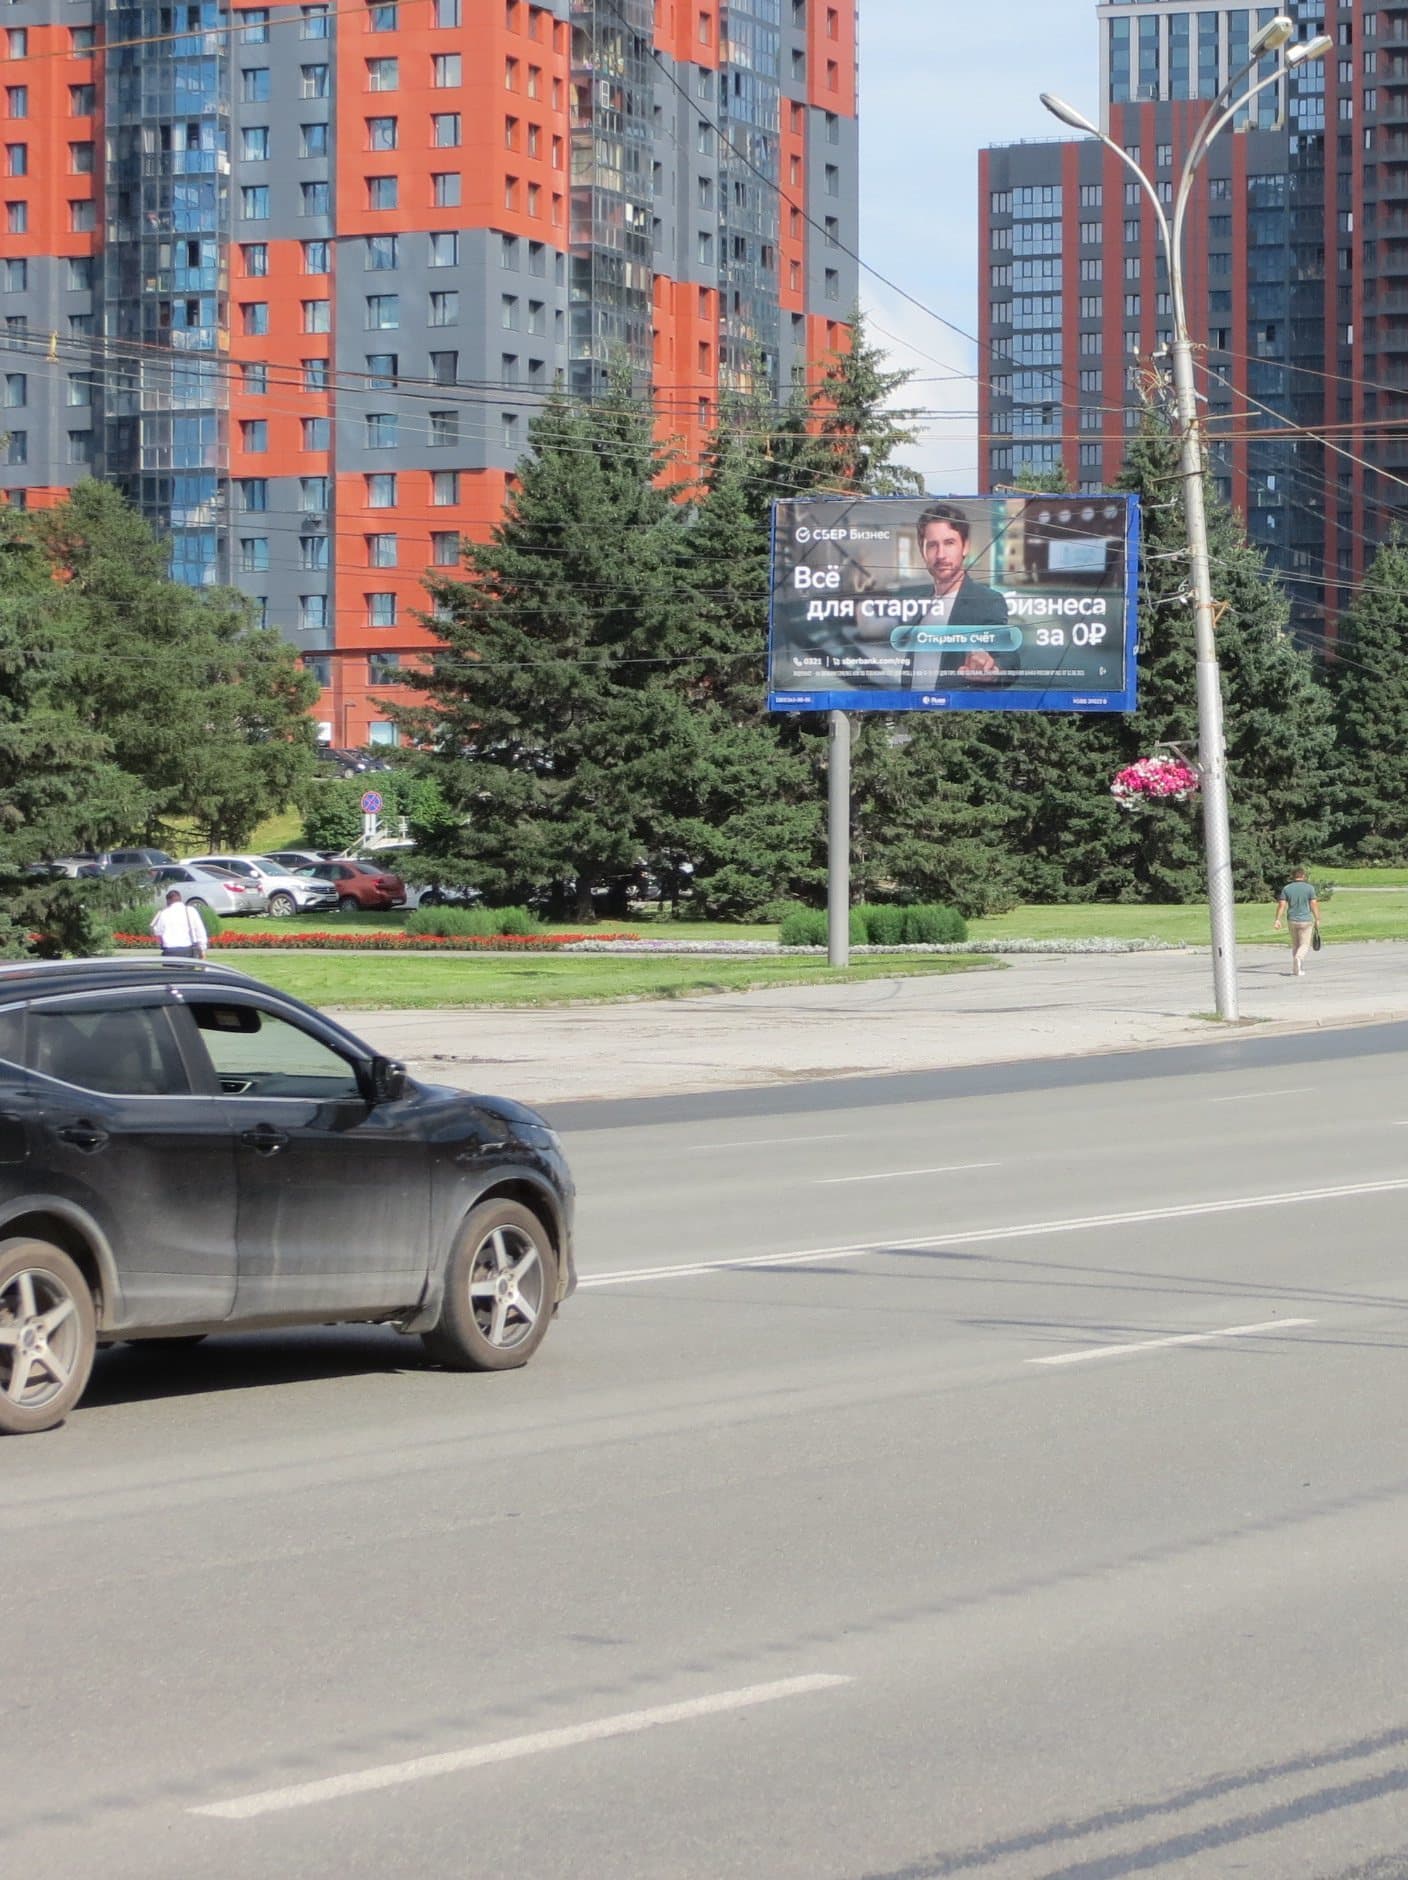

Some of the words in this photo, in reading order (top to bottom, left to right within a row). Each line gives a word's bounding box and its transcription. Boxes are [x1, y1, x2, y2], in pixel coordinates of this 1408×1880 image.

[812, 529, 847, 541] СБЕР
[850, 528, 890, 541] Бизнес
[794, 566, 840, 589] Всё
[807, 601, 853, 621] для
[862, 601, 944, 620] старта
[1003, 591, 1106, 615] бизнеса
[916, 631, 967, 645] Открыть
[970, 631, 995, 644] счёт
[1036, 628, 1065, 646] за
